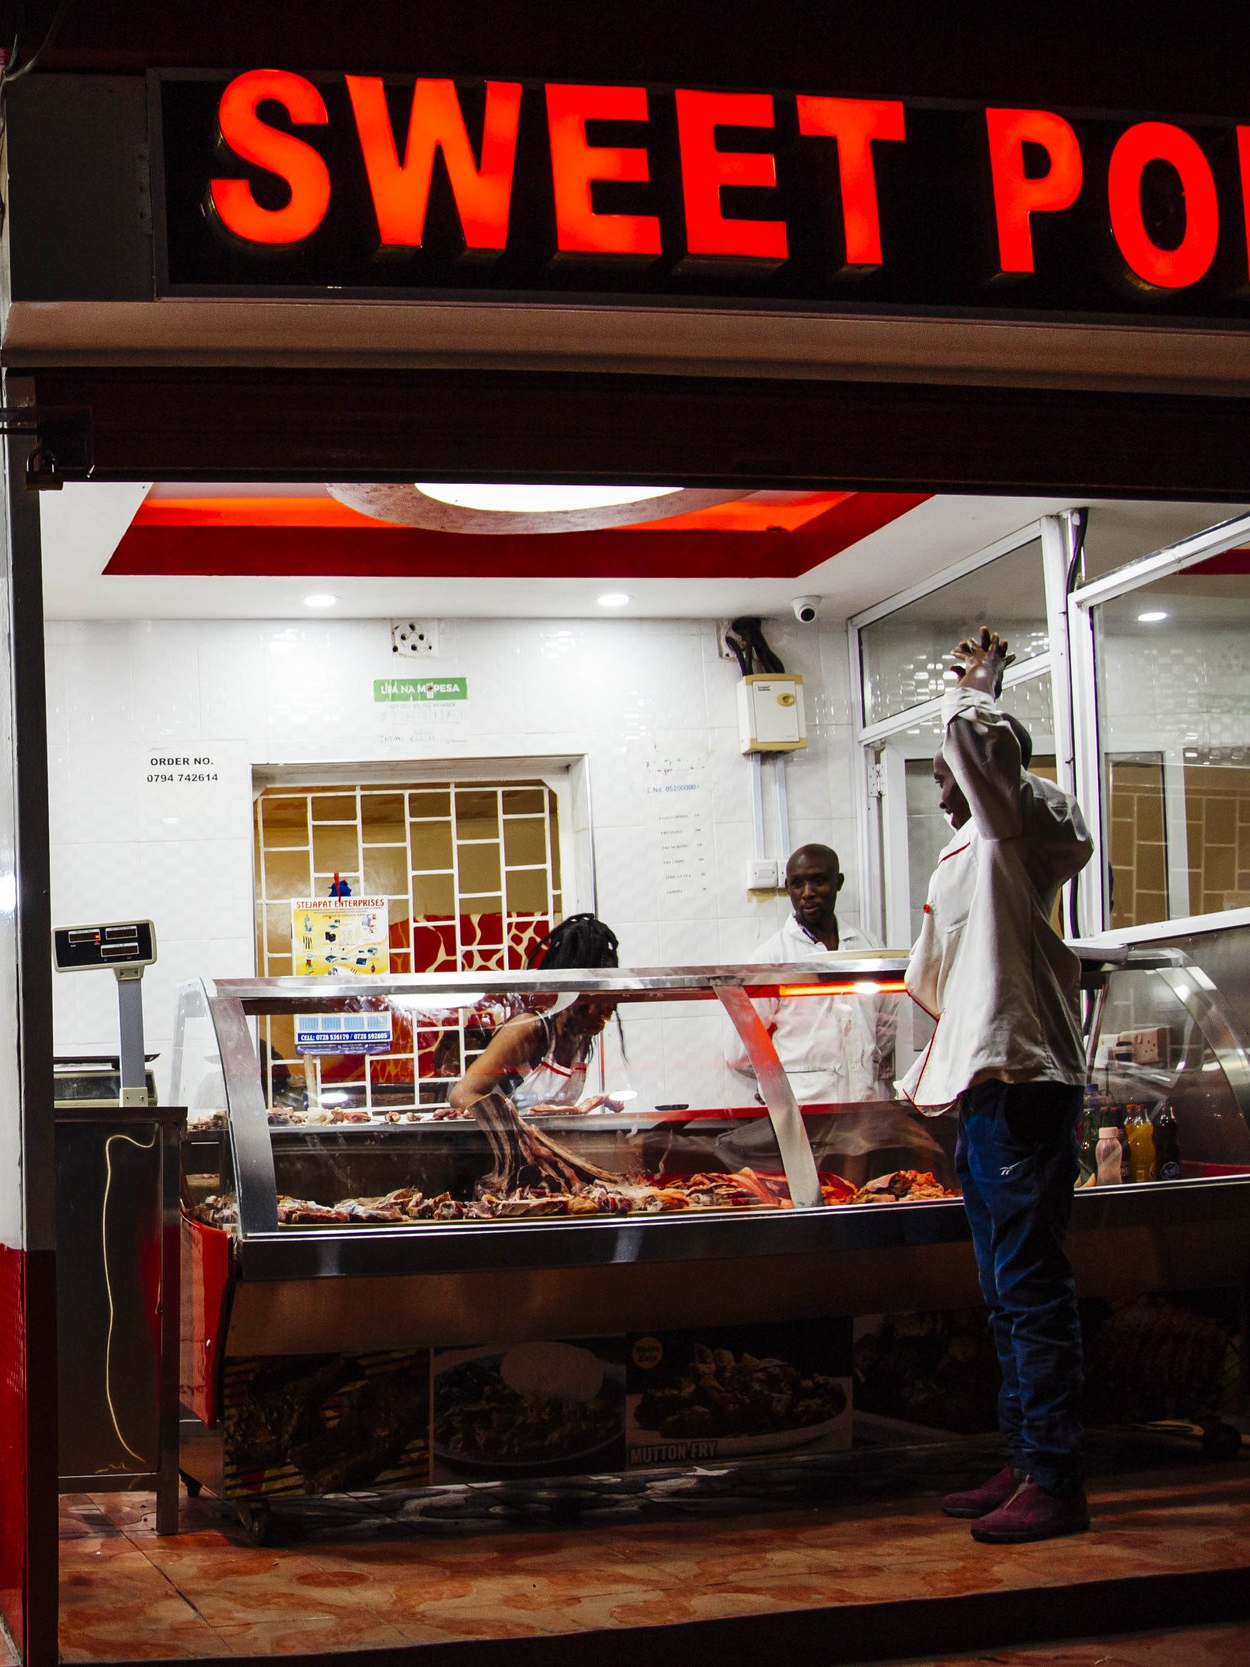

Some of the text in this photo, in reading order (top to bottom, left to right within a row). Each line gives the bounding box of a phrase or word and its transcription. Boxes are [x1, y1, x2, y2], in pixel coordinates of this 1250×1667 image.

[209, 68, 1250, 289] SWEET PO
[401, 684, 415, 694] NA
[417, 683, 460, 694] MPESA
[150, 757, 214, 766] ORDER NO.
[146, 773, 218, 783] 0794 742614
[296, 898, 385, 909] STEJAPAT ENTERPRISES
[630, 1440, 717, 1465] MUTTON FRY
